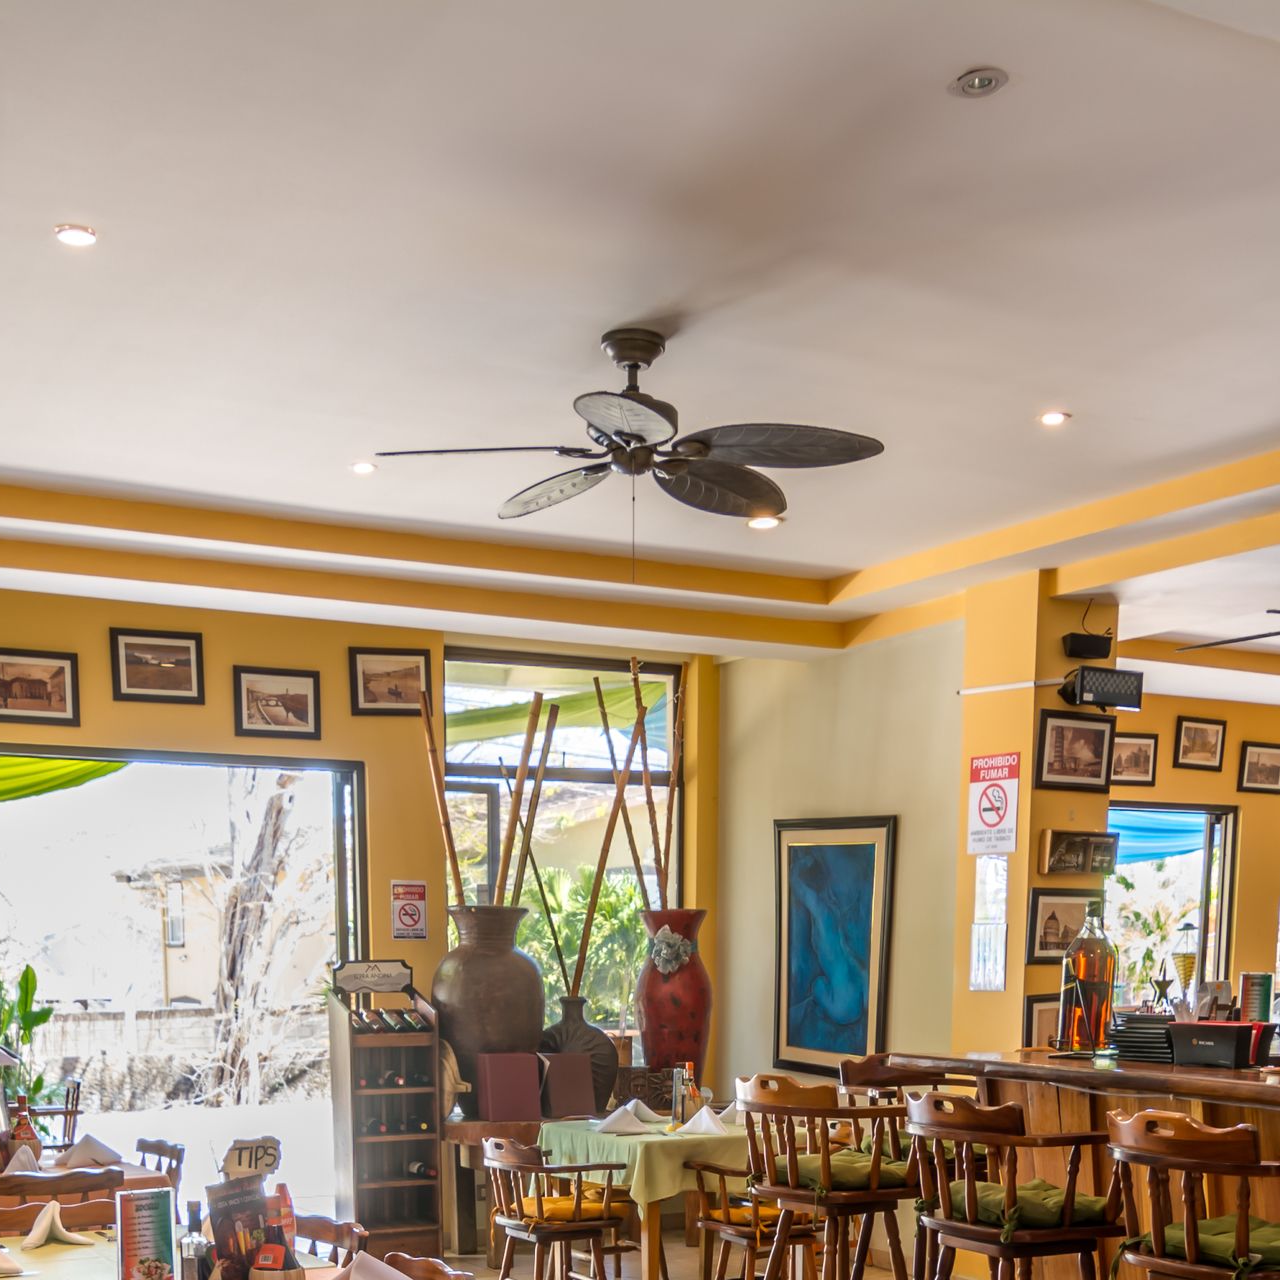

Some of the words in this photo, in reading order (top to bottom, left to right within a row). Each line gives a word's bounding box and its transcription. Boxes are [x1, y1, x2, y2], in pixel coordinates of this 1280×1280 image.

[972, 755, 1018, 770] PROHIBIDO
[980, 767, 1009, 780] FUMAR
[234, 1145, 277, 1170] TIPS
